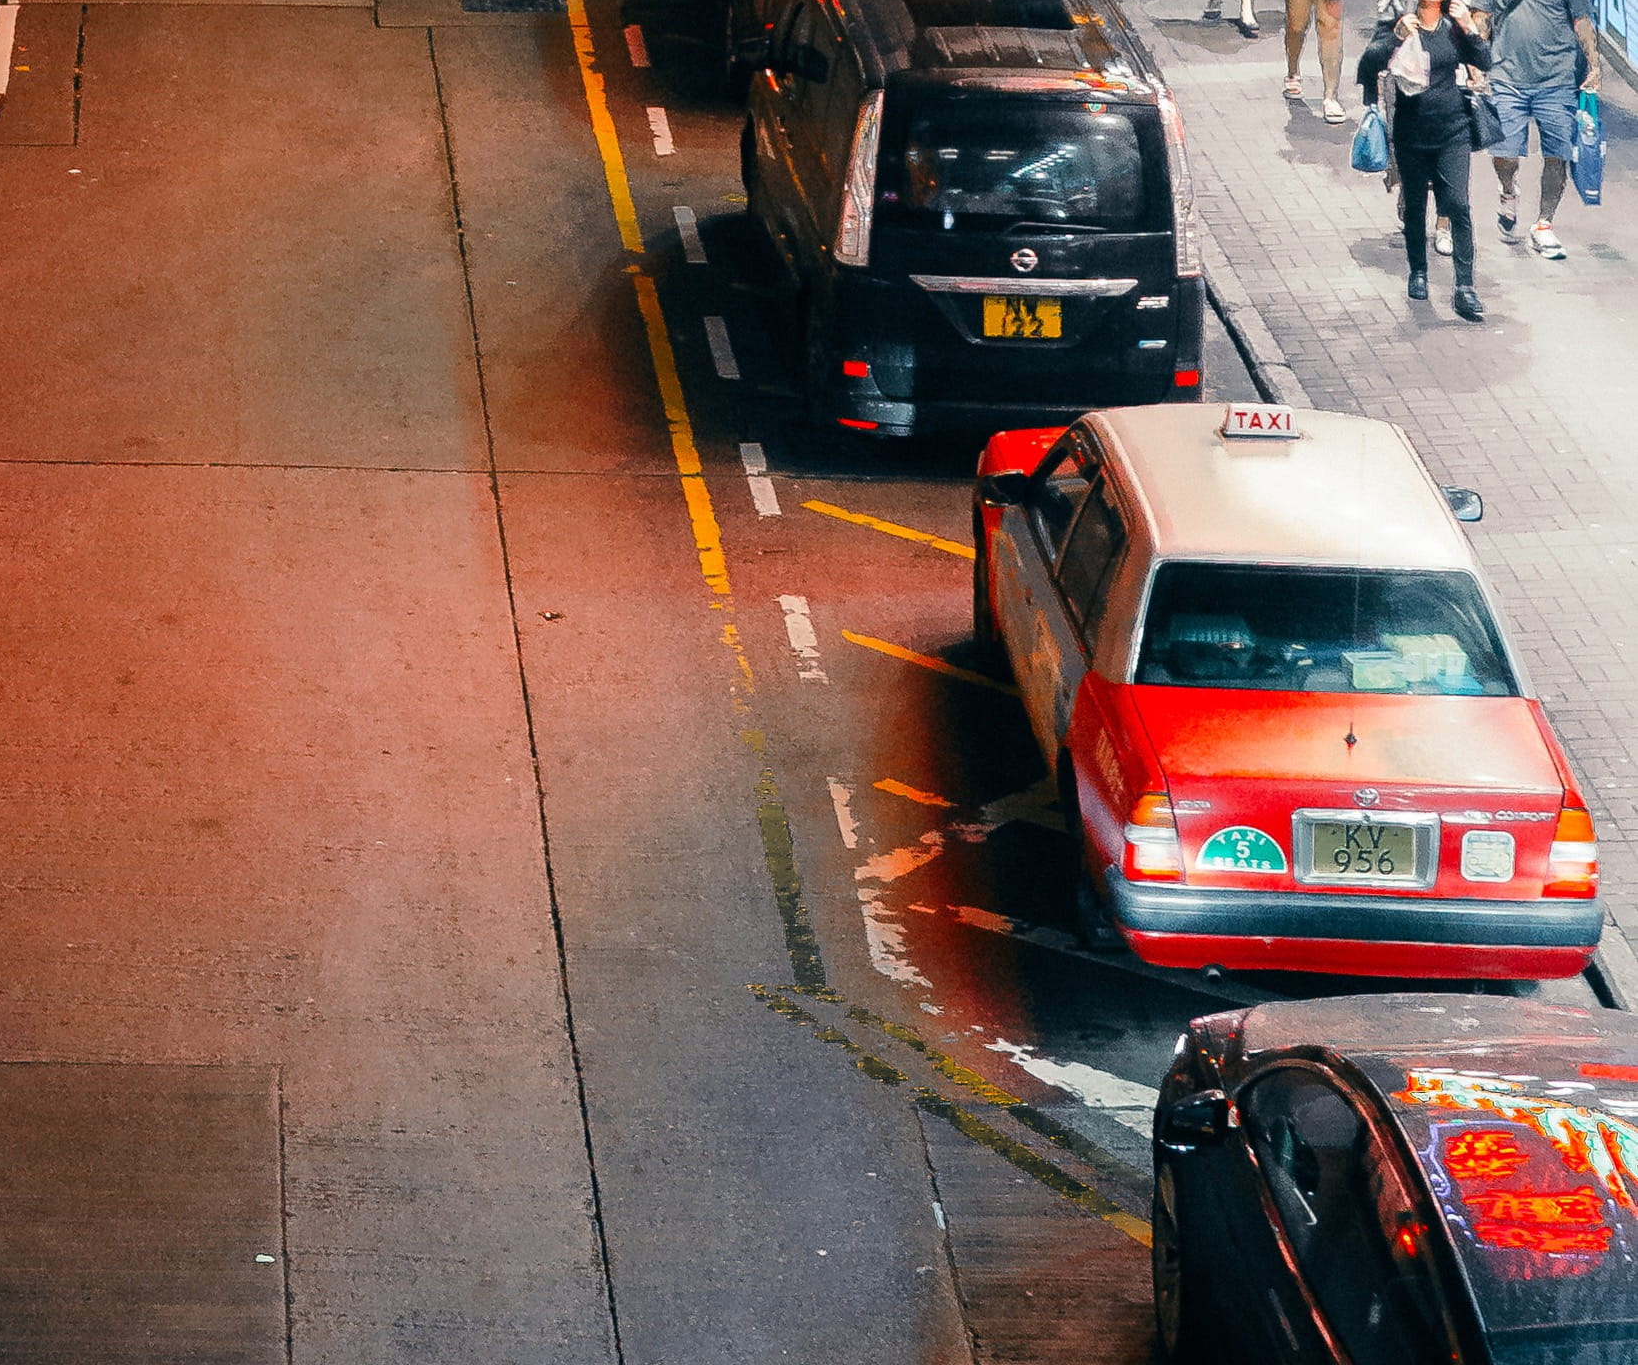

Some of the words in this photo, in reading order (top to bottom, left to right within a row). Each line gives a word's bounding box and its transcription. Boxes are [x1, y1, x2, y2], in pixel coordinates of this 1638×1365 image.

[1233, 410, 1292, 431] TAXI
[1216, 830, 1268, 846] TAXI
[1344, 823, 1385, 851] KV
[1235, 840, 1251, 858] 5
[1213, 855, 1272, 871] SEATS
[1333, 850, 1396, 875] 956
